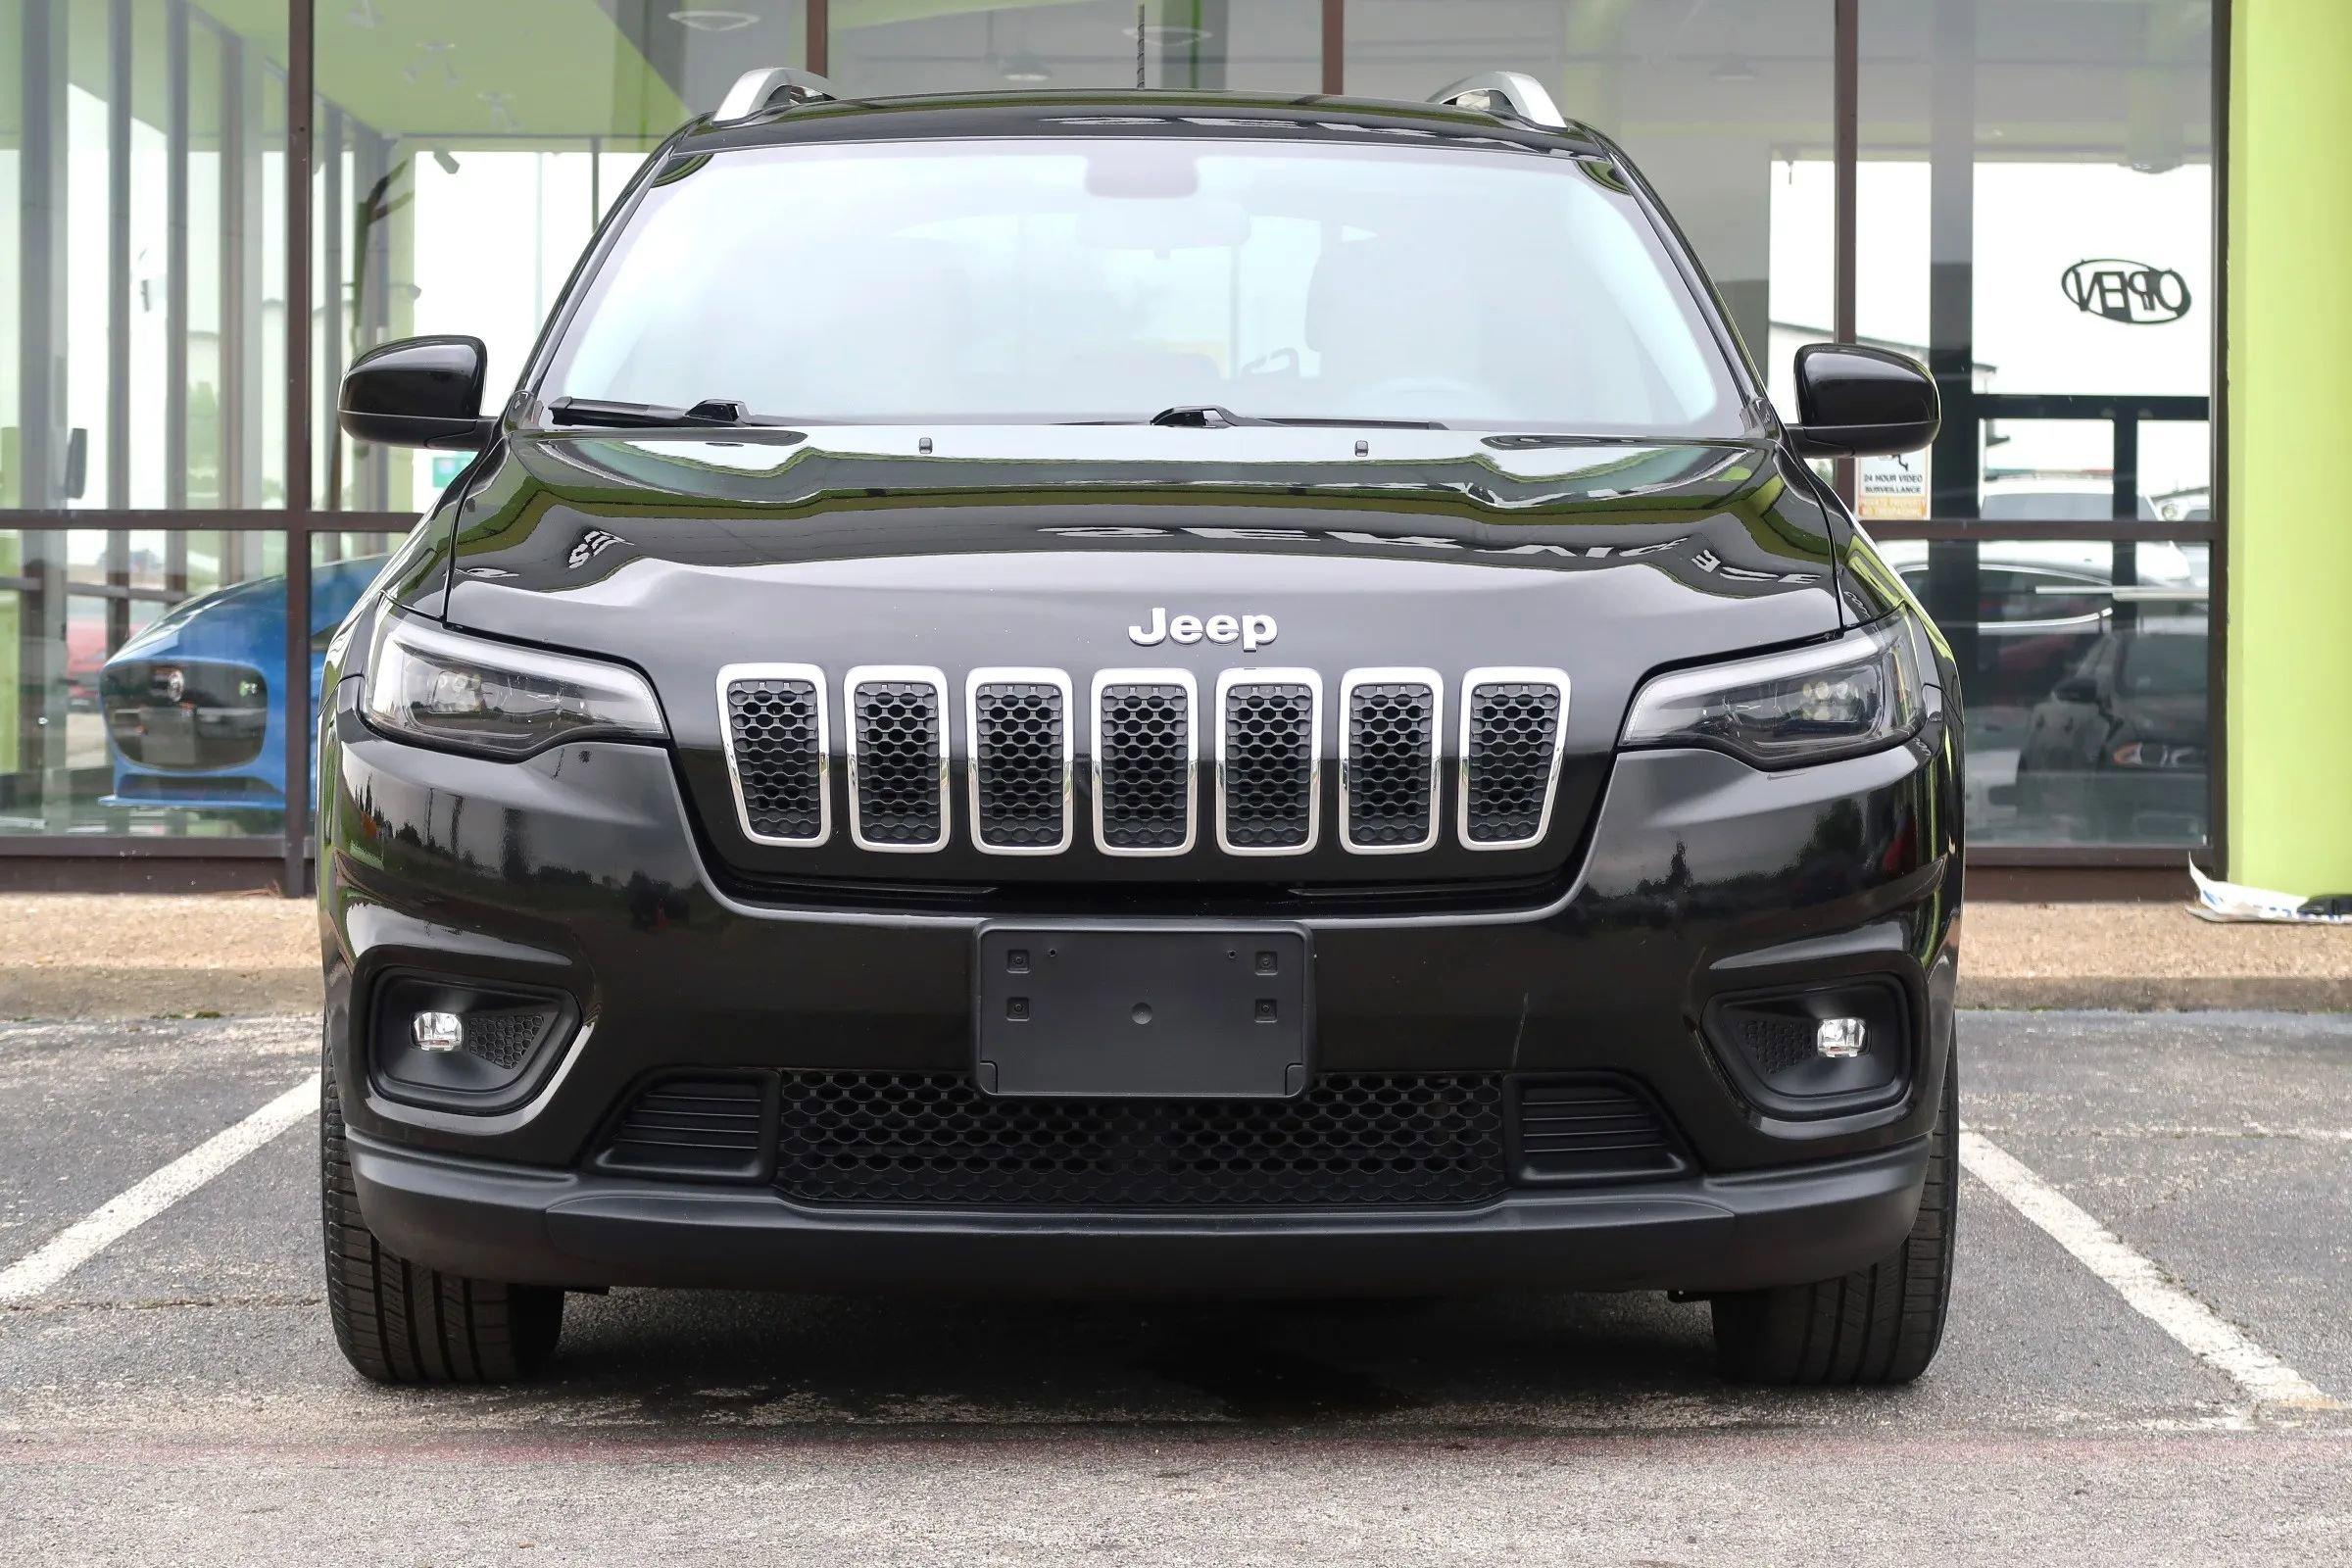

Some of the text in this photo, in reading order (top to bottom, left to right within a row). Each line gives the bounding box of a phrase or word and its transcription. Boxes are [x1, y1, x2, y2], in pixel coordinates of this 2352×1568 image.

[1864, 474, 1923, 483] 24 HOUR VIDEO
[1128, 607, 1278, 653] Jeep
